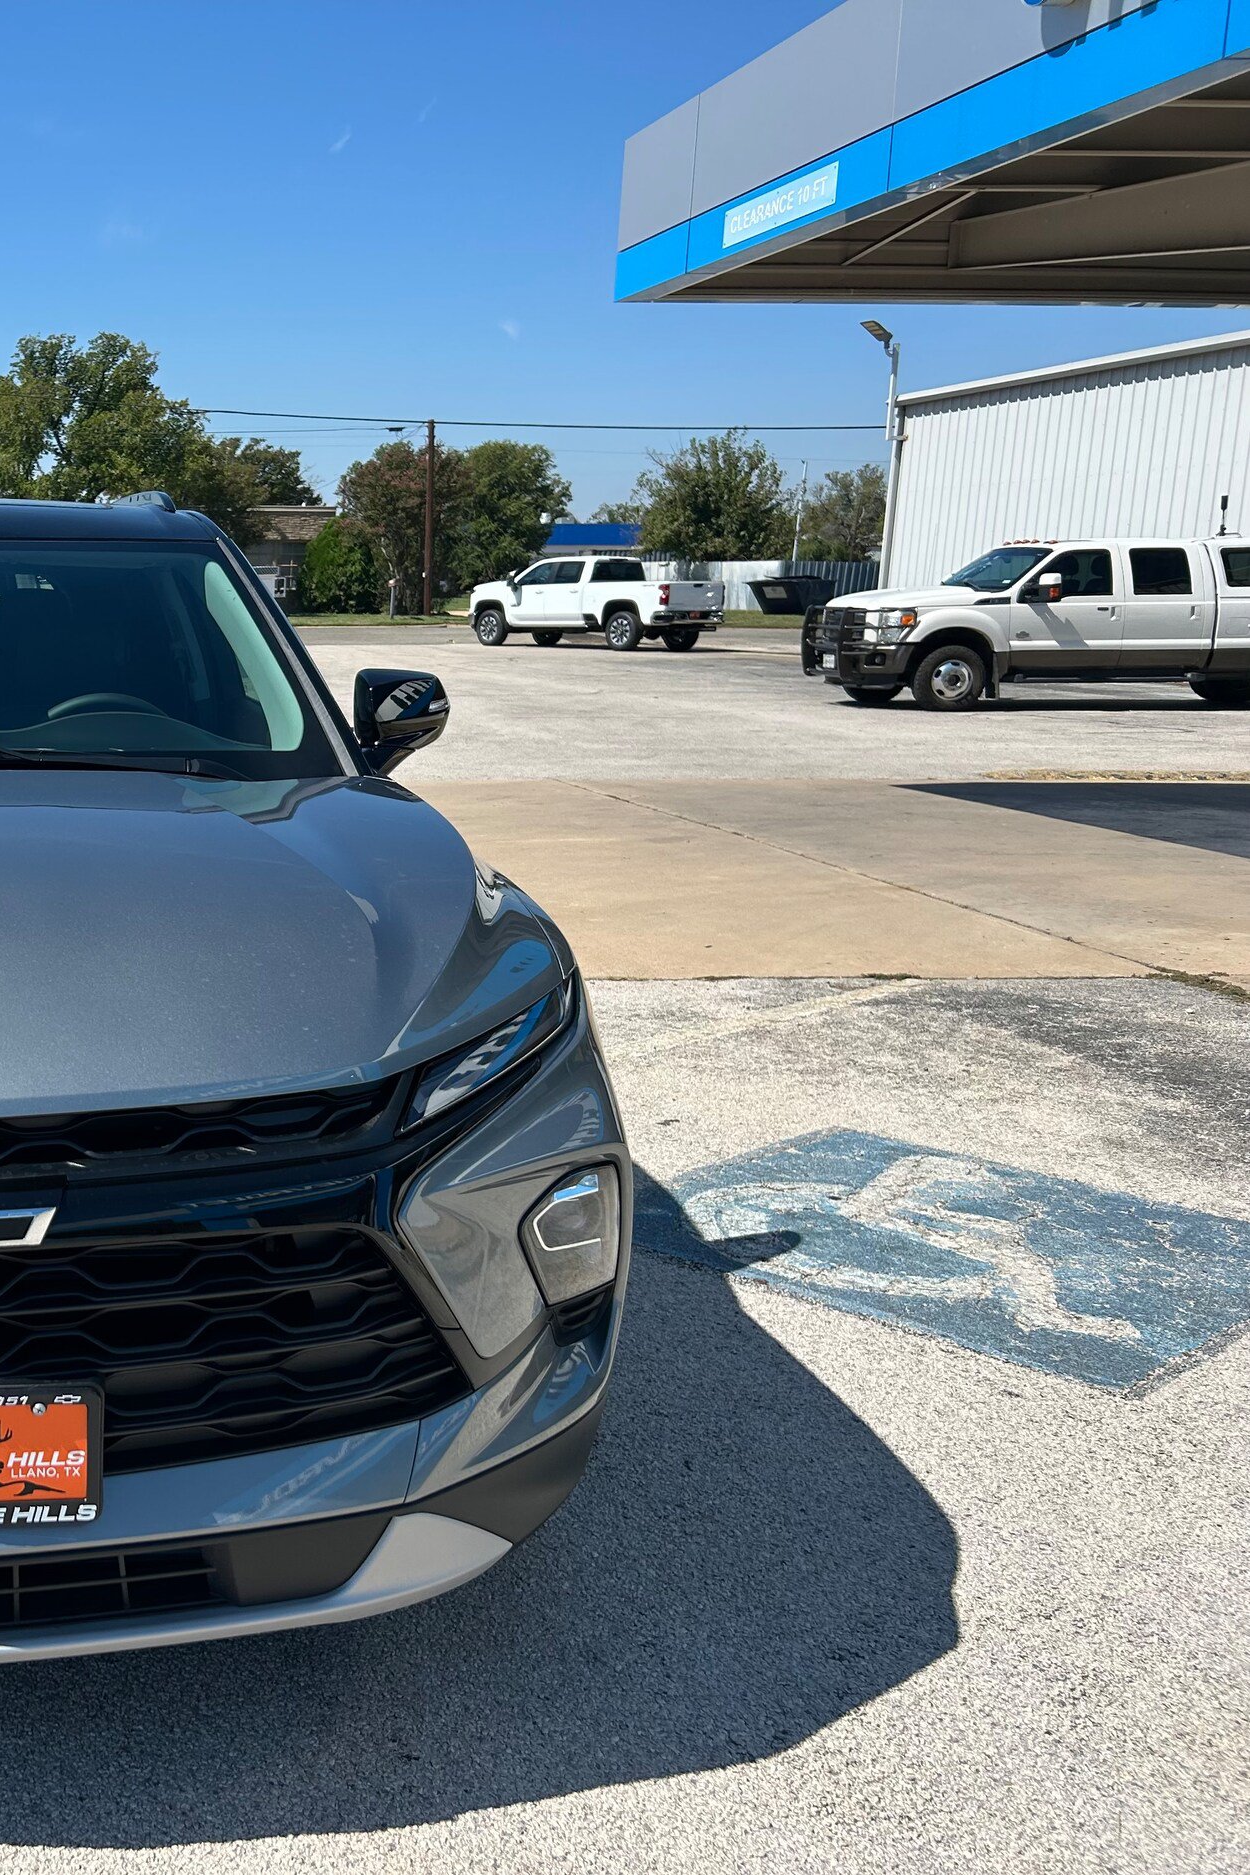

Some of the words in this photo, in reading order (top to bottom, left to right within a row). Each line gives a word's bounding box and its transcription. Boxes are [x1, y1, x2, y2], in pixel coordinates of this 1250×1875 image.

[730, 190, 795, 234] CLEARANCE
[797, 185, 810, 206] 10
[812, 175, 829, 200] FT
[6, 1450, 86, 1468] HILLS
[10, 1466, 60, 1479] LLANO,
[64, 1466, 81, 1477] TX
[10, 1504, 98, 1523] HILLS
